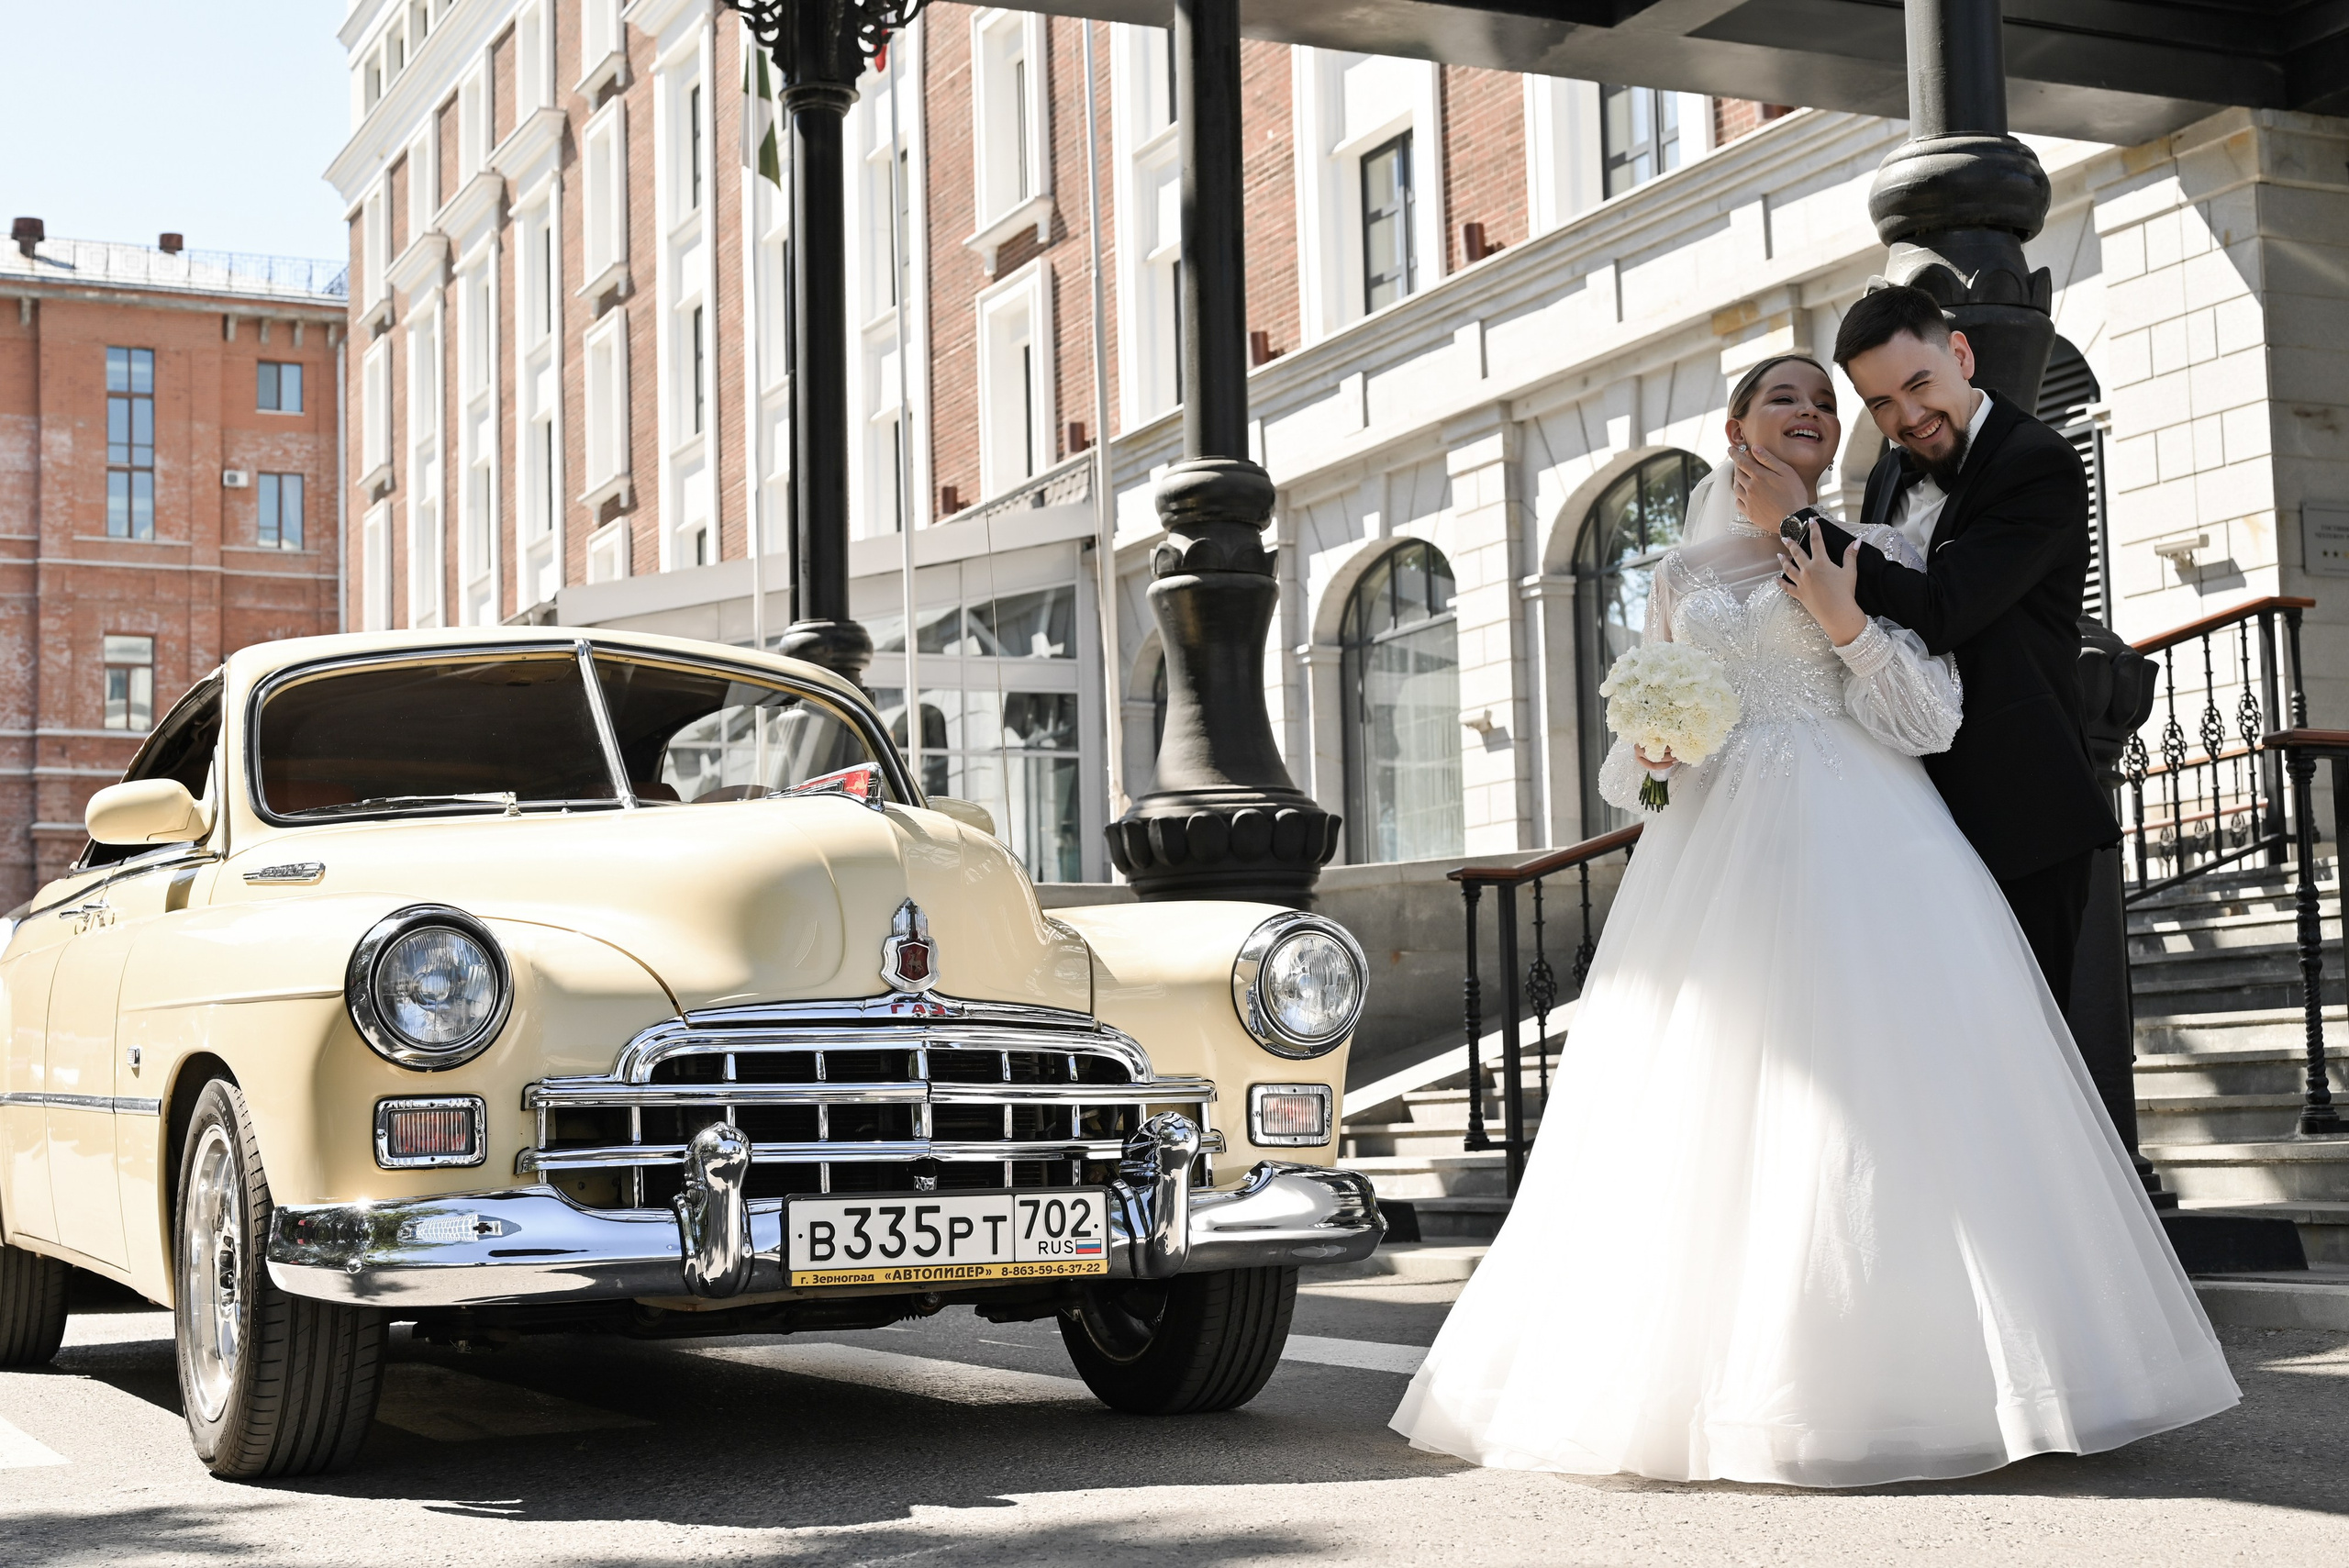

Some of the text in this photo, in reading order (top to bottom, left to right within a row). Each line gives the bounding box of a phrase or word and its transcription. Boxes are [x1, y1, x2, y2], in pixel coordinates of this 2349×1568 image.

[890, 1003, 946, 1015] ГАЗ
[1019, 1197, 1092, 1240] 702
[809, 1205, 1008, 1262] В335РТ
[1038, 1240, 1074, 1255] RUS
[800, 1262, 1101, 1285] г. Зерноград «АВТОЛИДЕР» 8-863-59-6-37-22
